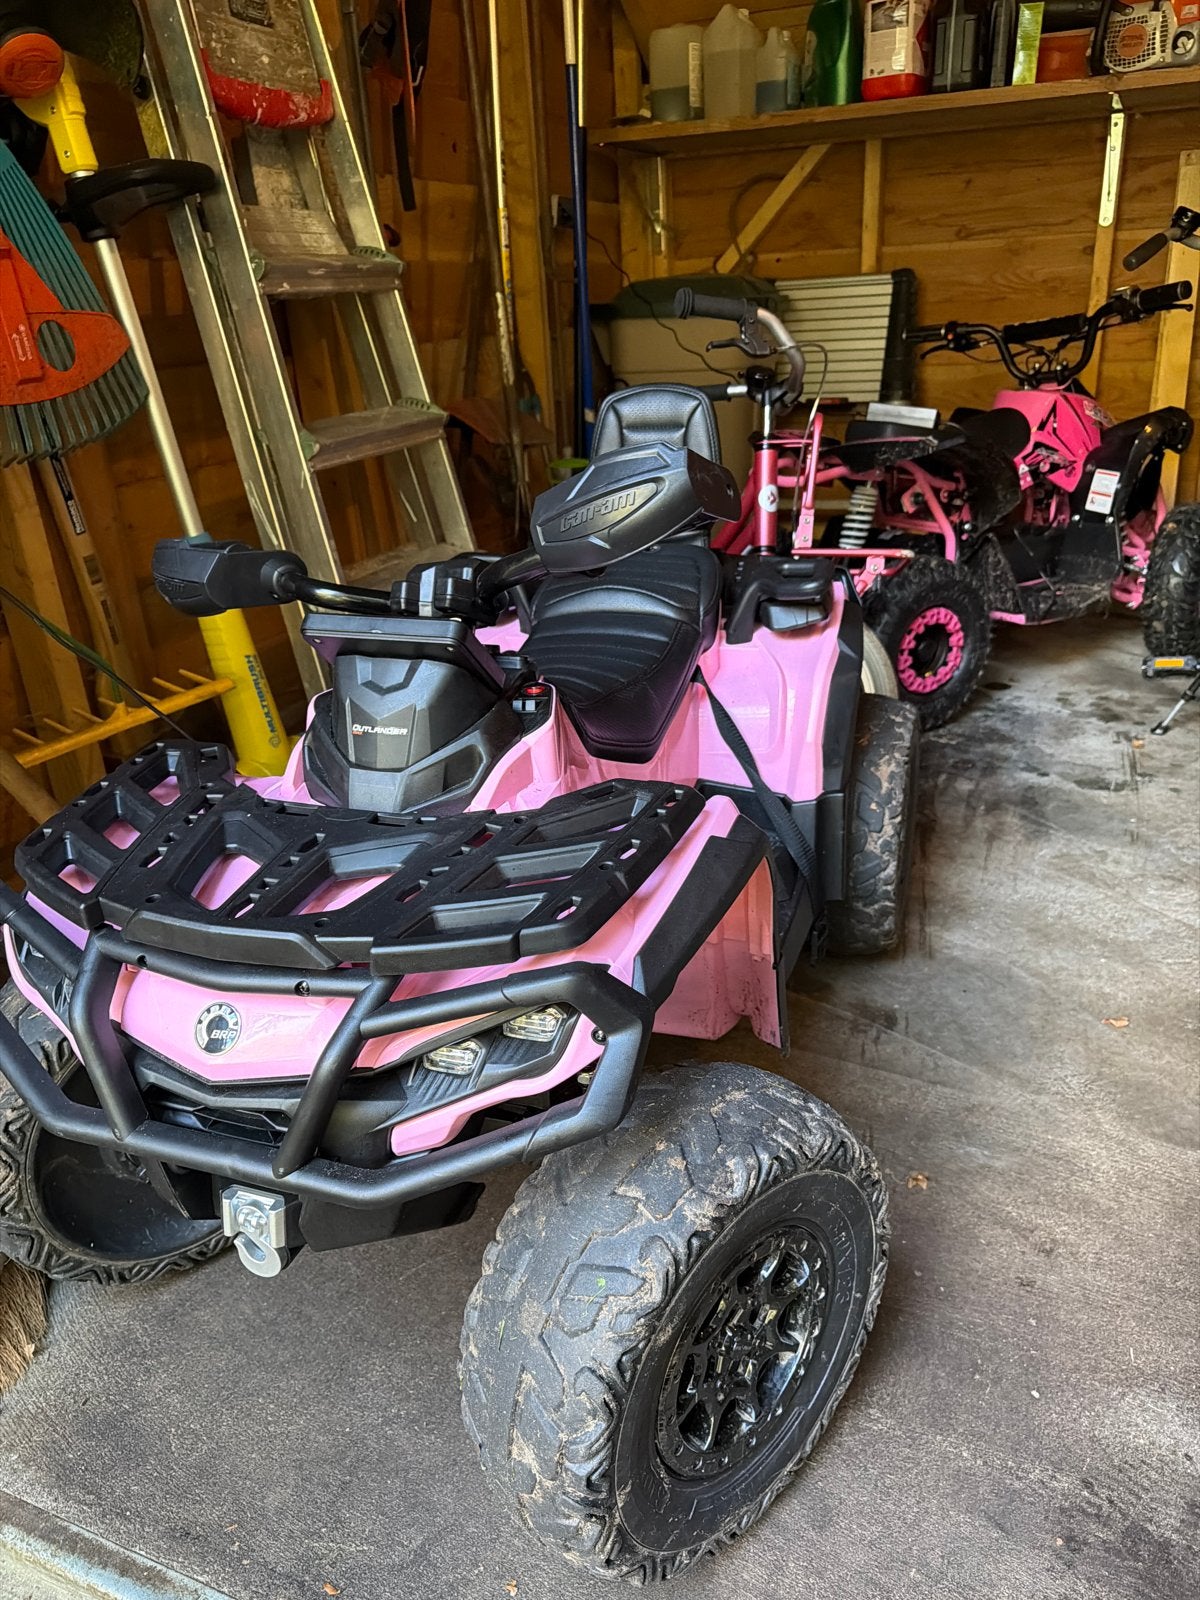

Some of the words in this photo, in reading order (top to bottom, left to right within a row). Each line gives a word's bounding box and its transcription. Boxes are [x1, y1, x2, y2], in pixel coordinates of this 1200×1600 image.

[244, 654, 277, 733] MULTIBRUSH
[352, 724, 408, 736] OUTLANDER
[210, 1029, 237, 1040] BRP
